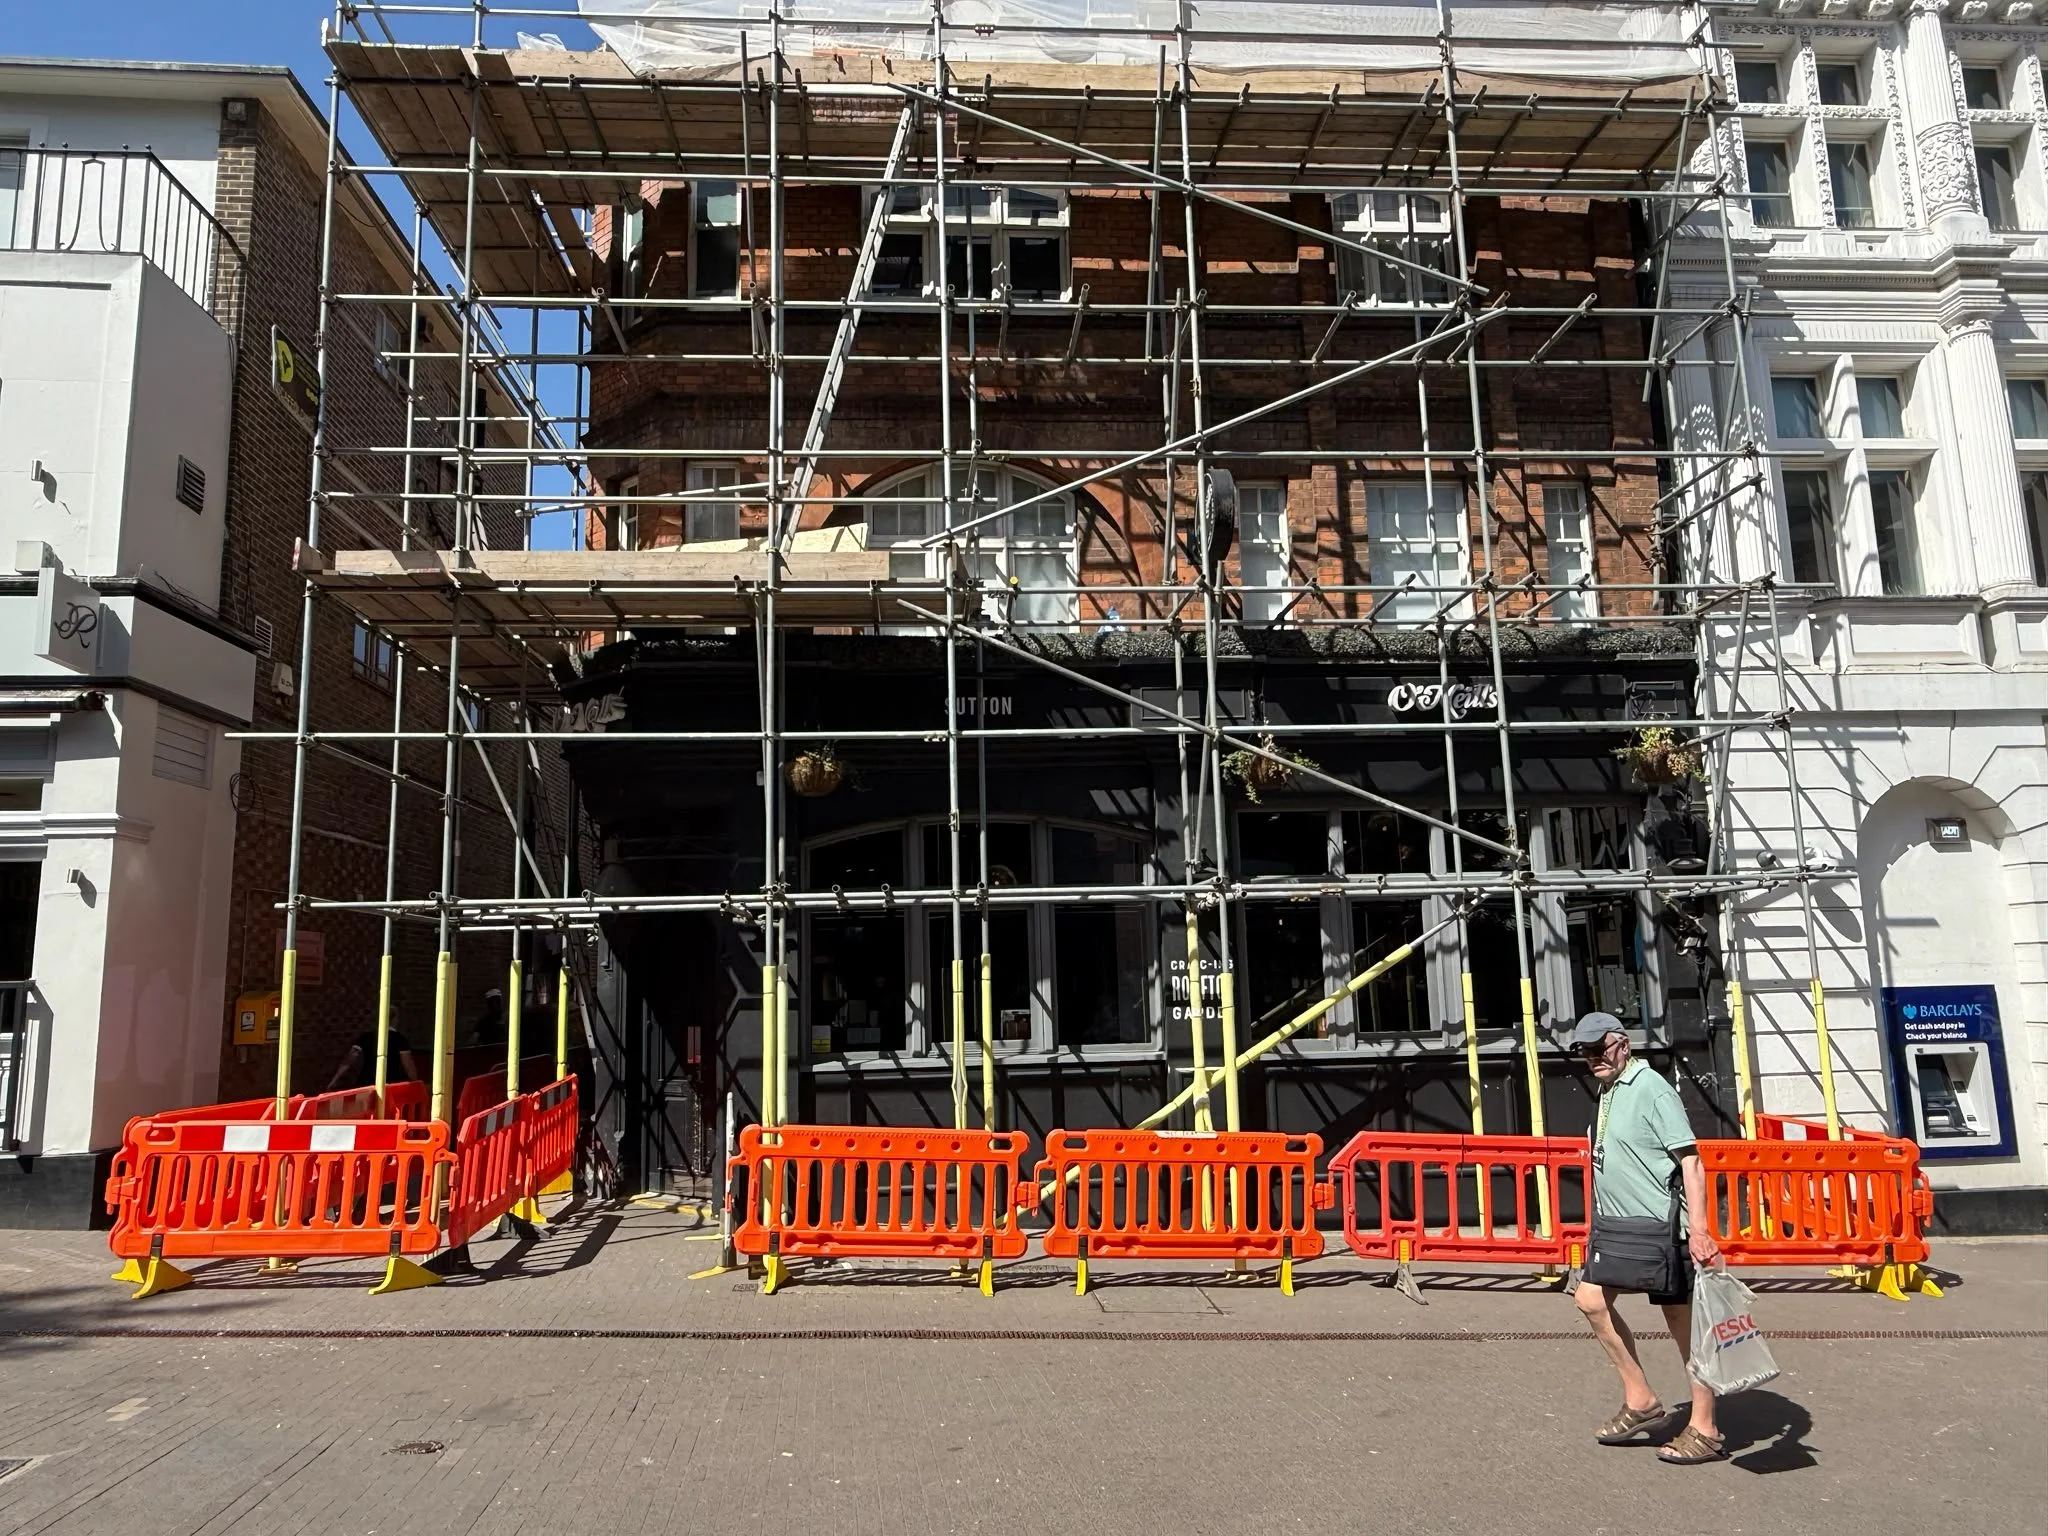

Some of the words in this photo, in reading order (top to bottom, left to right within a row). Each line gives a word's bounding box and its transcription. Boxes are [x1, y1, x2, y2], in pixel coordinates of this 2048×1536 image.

[1941, 825, 1960, 838] ADT
[1171, 974, 1223, 1001] ROFTO
[1172, 1006, 1225, 1019] GADE
[1920, 1003, 1982, 1017] BARCLAYS
[1904, 1022, 1917, 1030] Get
[1917, 1022, 1933, 1030] cash
[1933, 1022, 1945, 1030] and
[1945, 1023, 1958, 1031] pay
[1958, 1021, 1966, 1029] in
[1905, 1032, 1926, 1040] Check
[1927, 1033, 1941, 1041] your
